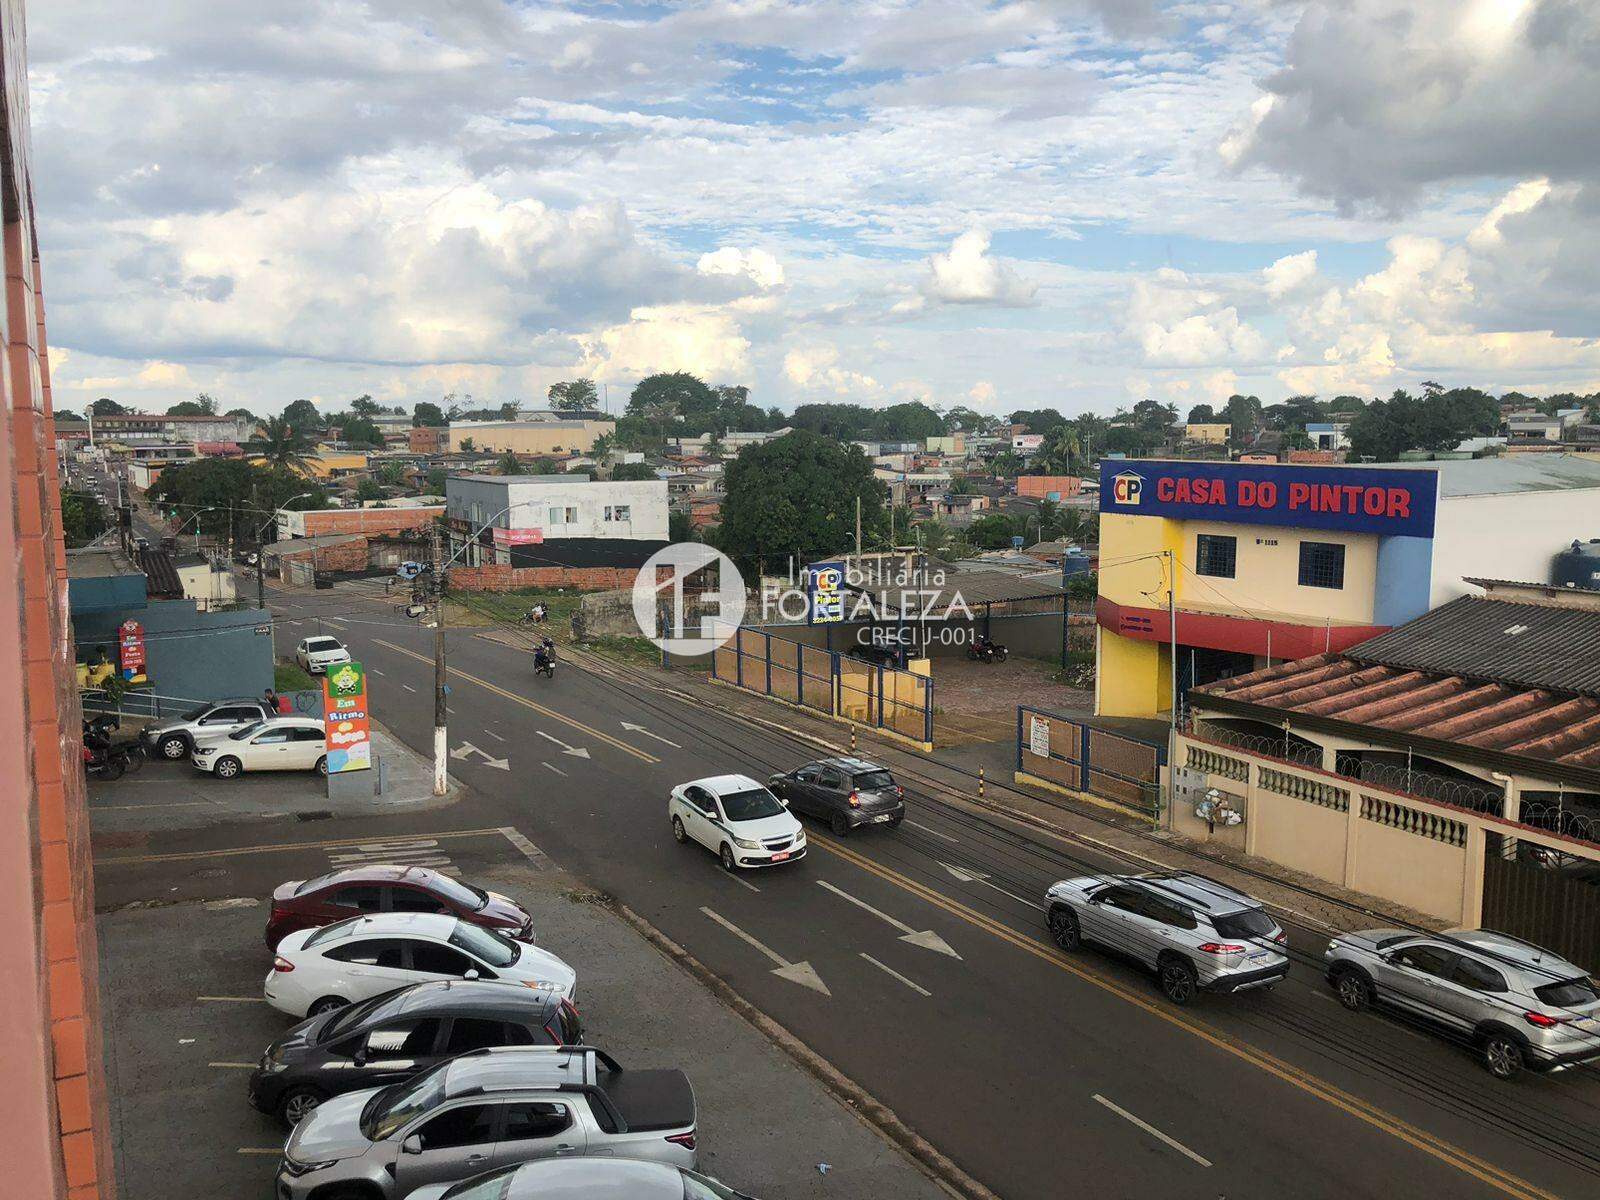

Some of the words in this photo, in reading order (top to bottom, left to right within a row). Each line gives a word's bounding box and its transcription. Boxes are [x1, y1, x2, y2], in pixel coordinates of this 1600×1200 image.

[1114, 478, 1140, 501] CP
[1157, 477, 1227, 506] CASA
[1237, 480, 1277, 508] DO
[1289, 483, 1412, 518] PINTOR
[328, 711, 366, 721] Ritmo
